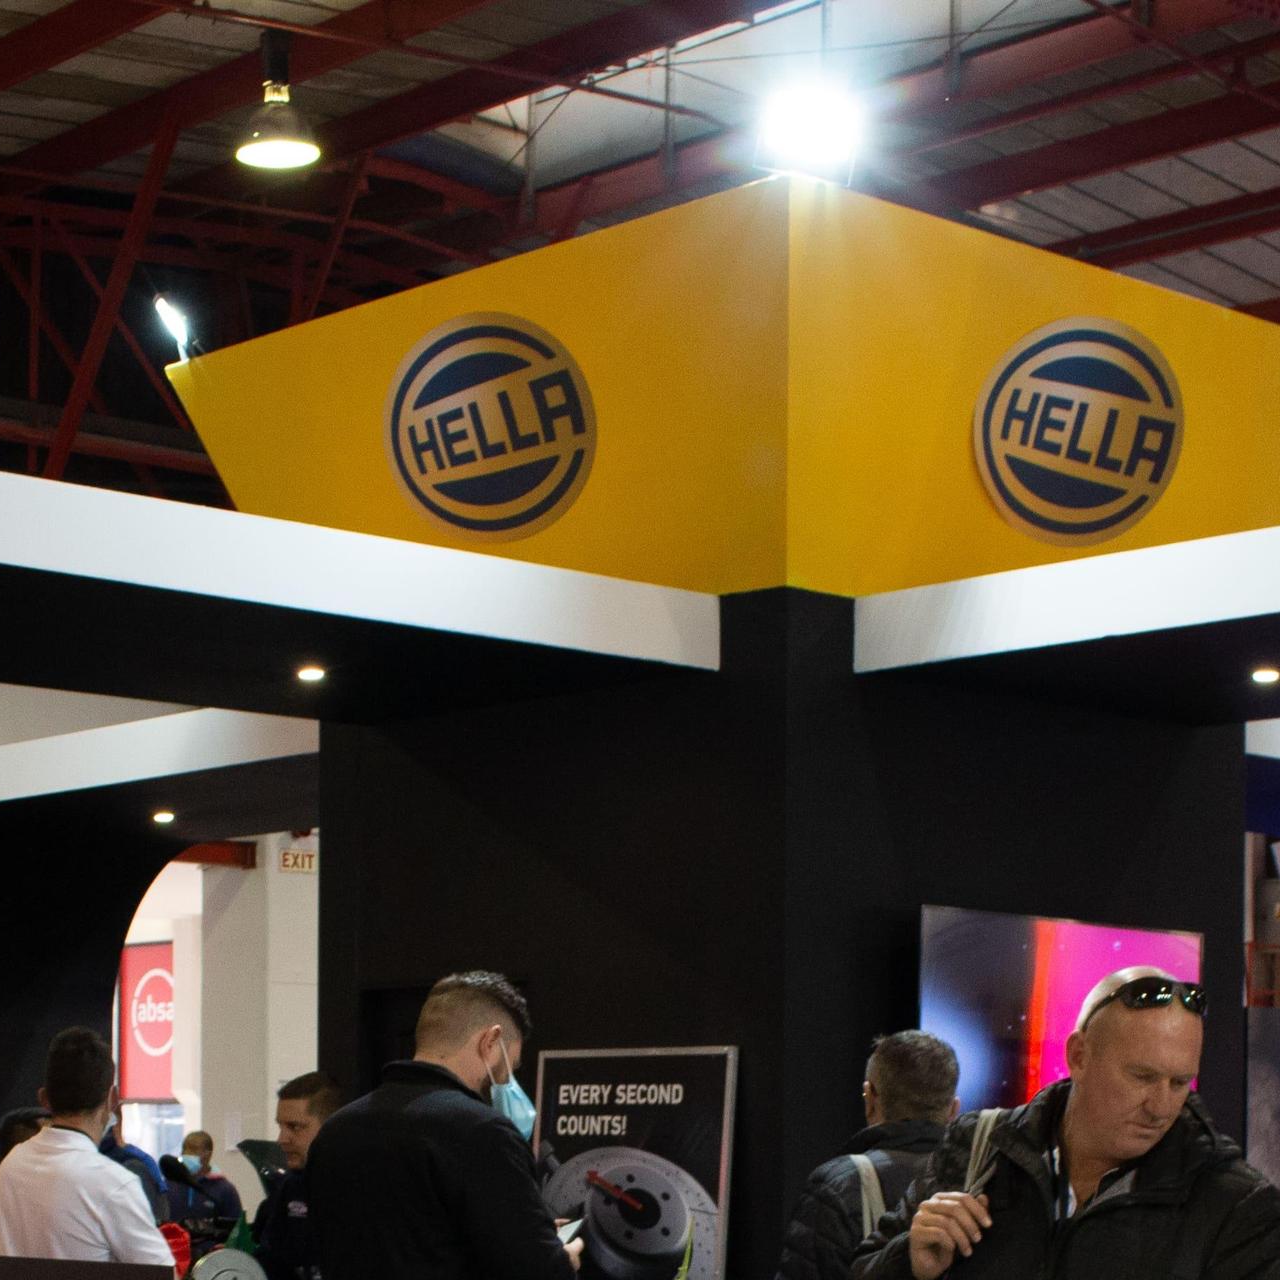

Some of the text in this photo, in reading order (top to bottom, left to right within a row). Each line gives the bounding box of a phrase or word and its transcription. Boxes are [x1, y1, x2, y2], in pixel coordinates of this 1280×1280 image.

[408, 369, 586, 474] HELLA
[1001, 388, 1175, 484] HELLA
[282, 852, 314, 869] EXIT
[558, 1083, 684, 1106] EVERY SECOND
[556, 1114, 628, 1136] COUNTS!
